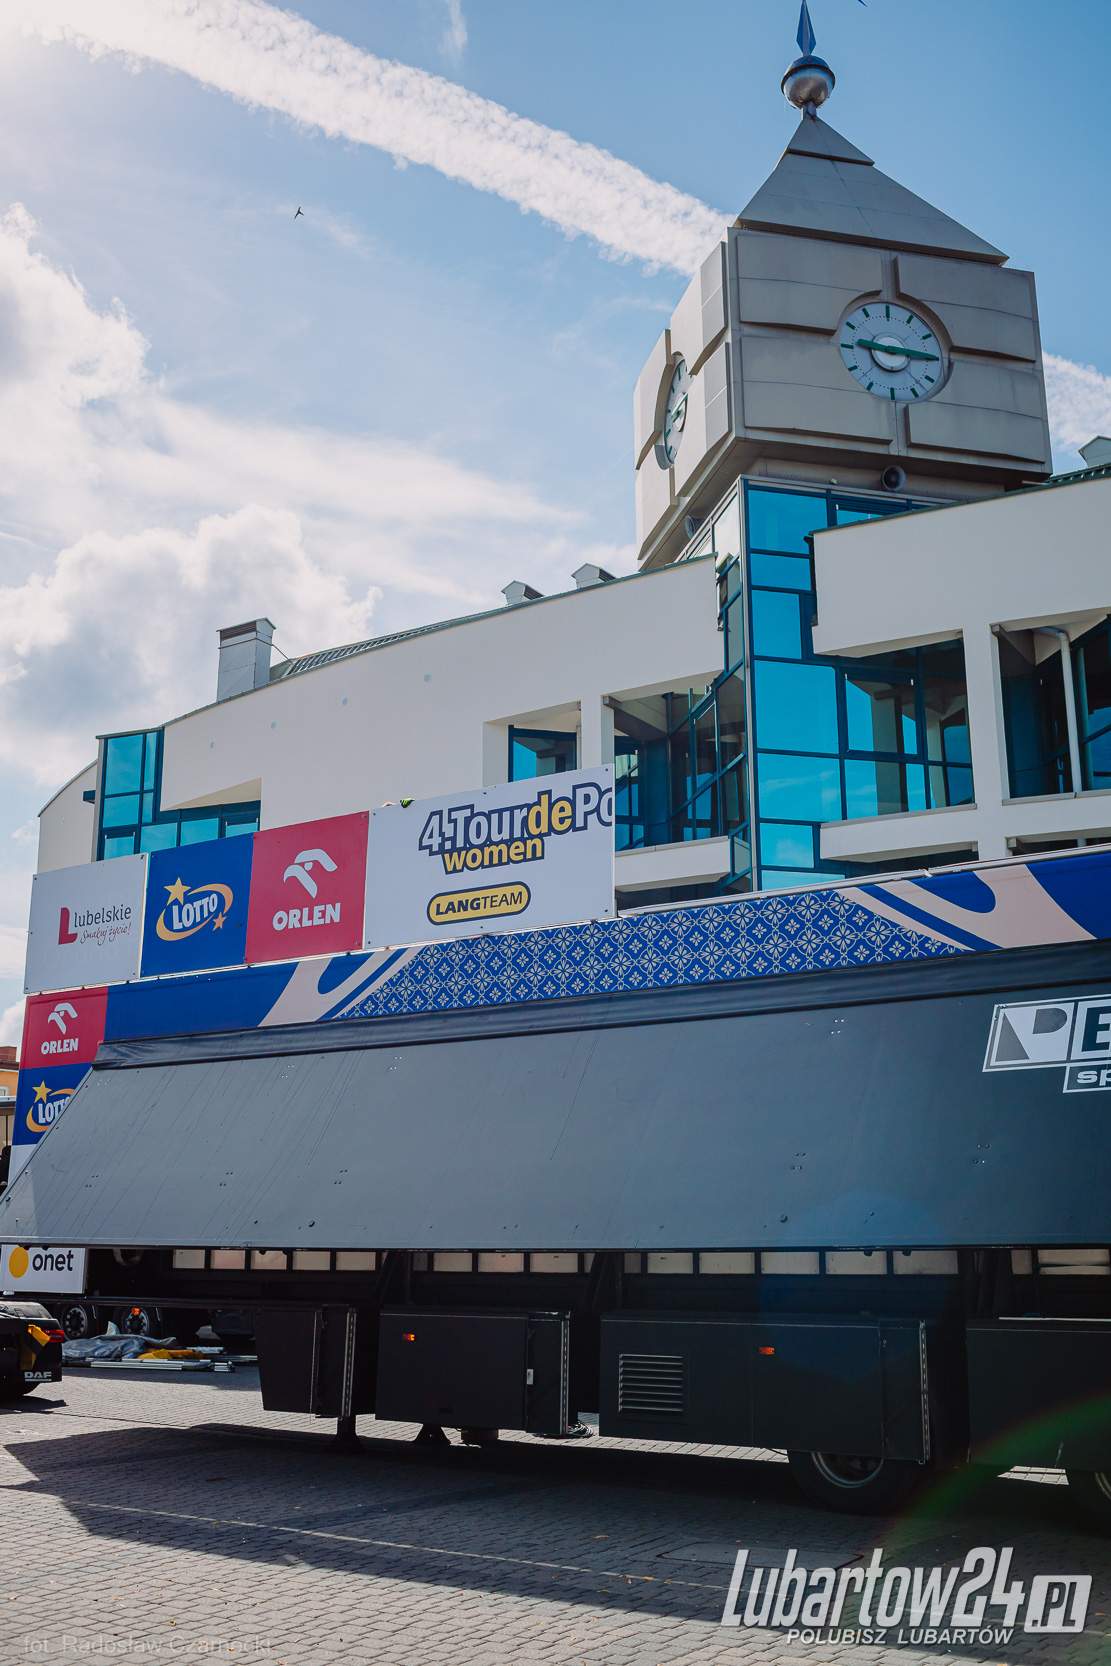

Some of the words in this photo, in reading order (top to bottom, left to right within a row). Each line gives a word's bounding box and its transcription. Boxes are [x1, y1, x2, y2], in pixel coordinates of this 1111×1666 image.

[442, 837, 545, 875] women
[172, 893, 218, 930] LOTTO
[435, 891, 523, 916] LANGTEAM
[272, 902, 341, 931] ORLEN
[41, 1037, 79, 1055] ORLEN
[32, 1249, 74, 1272] onet
[24, 1371, 52, 1379] DAF
